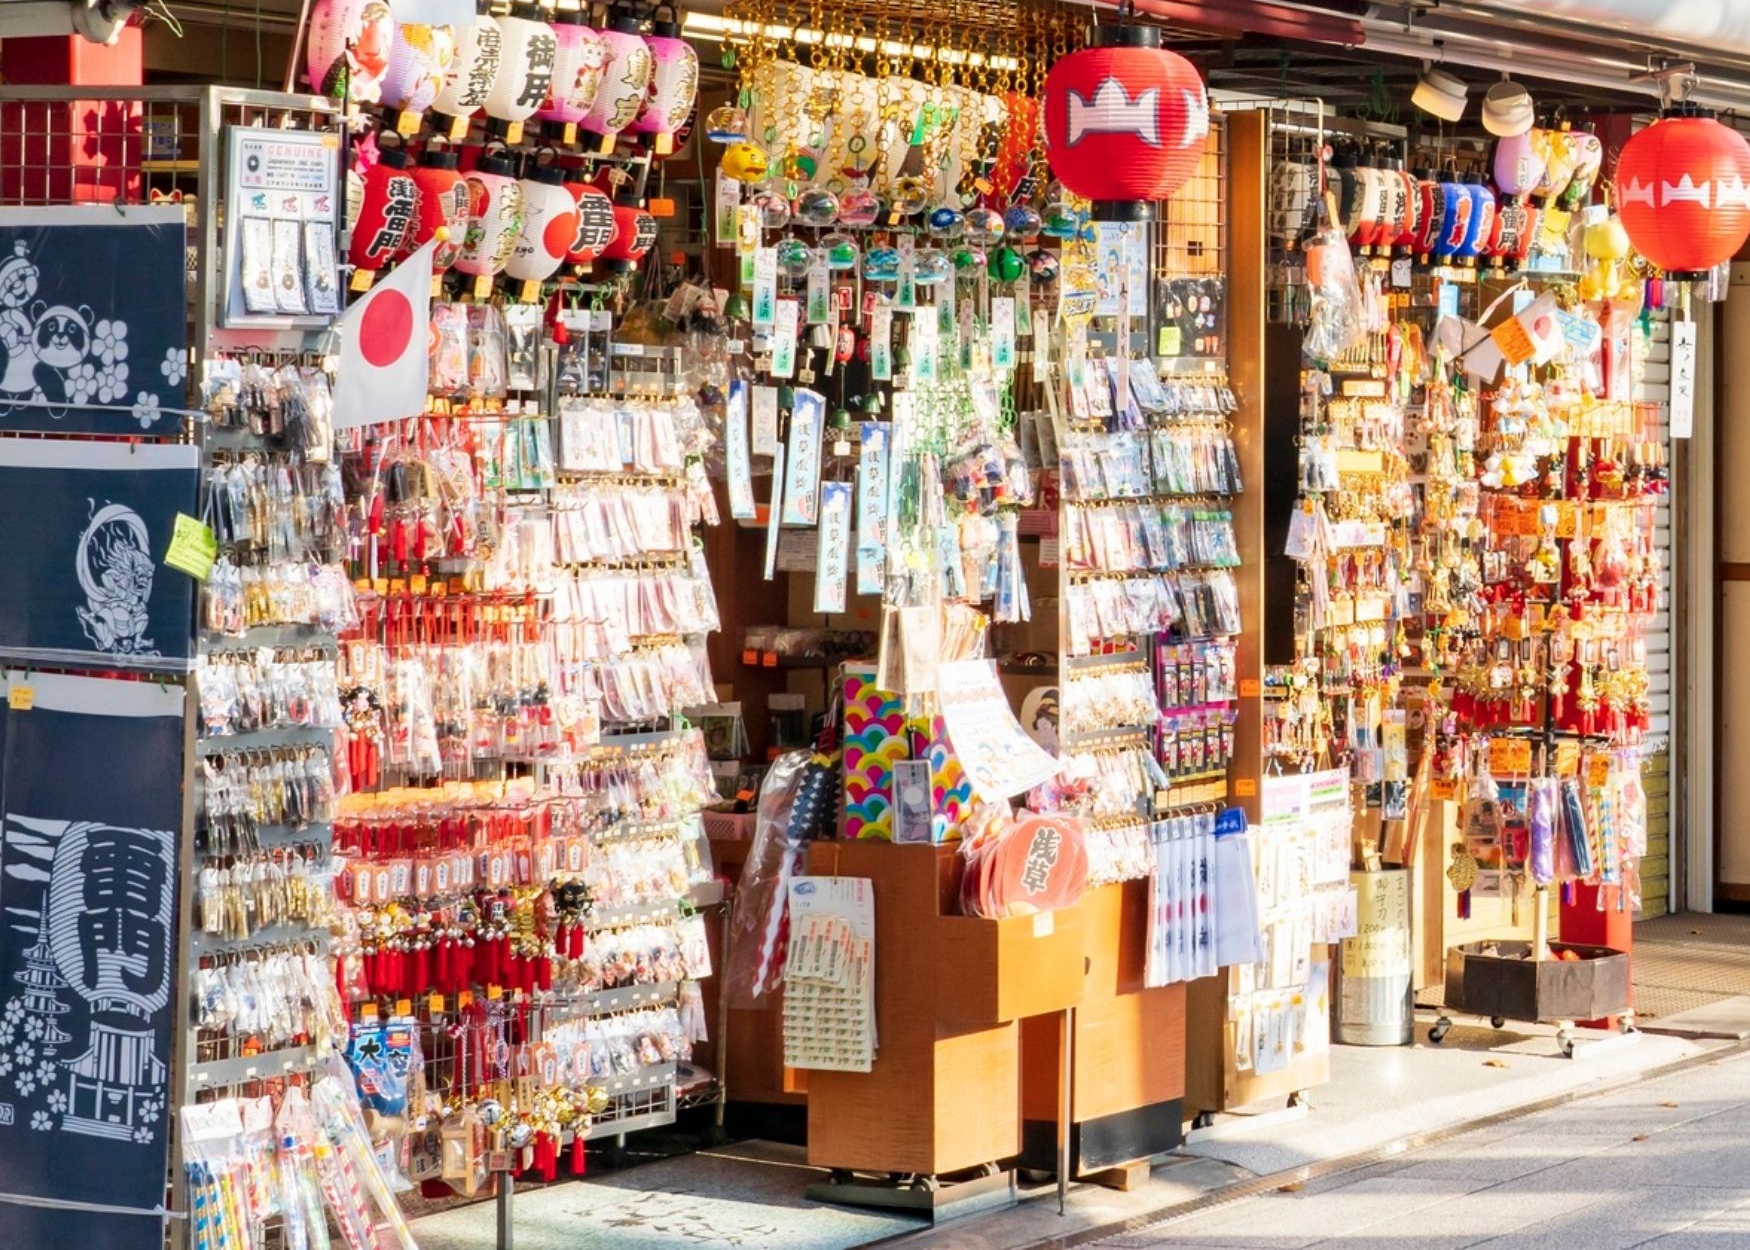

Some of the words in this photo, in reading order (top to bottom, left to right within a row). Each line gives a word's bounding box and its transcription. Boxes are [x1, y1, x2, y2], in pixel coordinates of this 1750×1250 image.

[516, 34, 556, 108] 御用
[571, 194, 614, 256] 雷門
[1023, 828, 1062, 894] 浅草
[78, 827, 166, 993] 雷門
